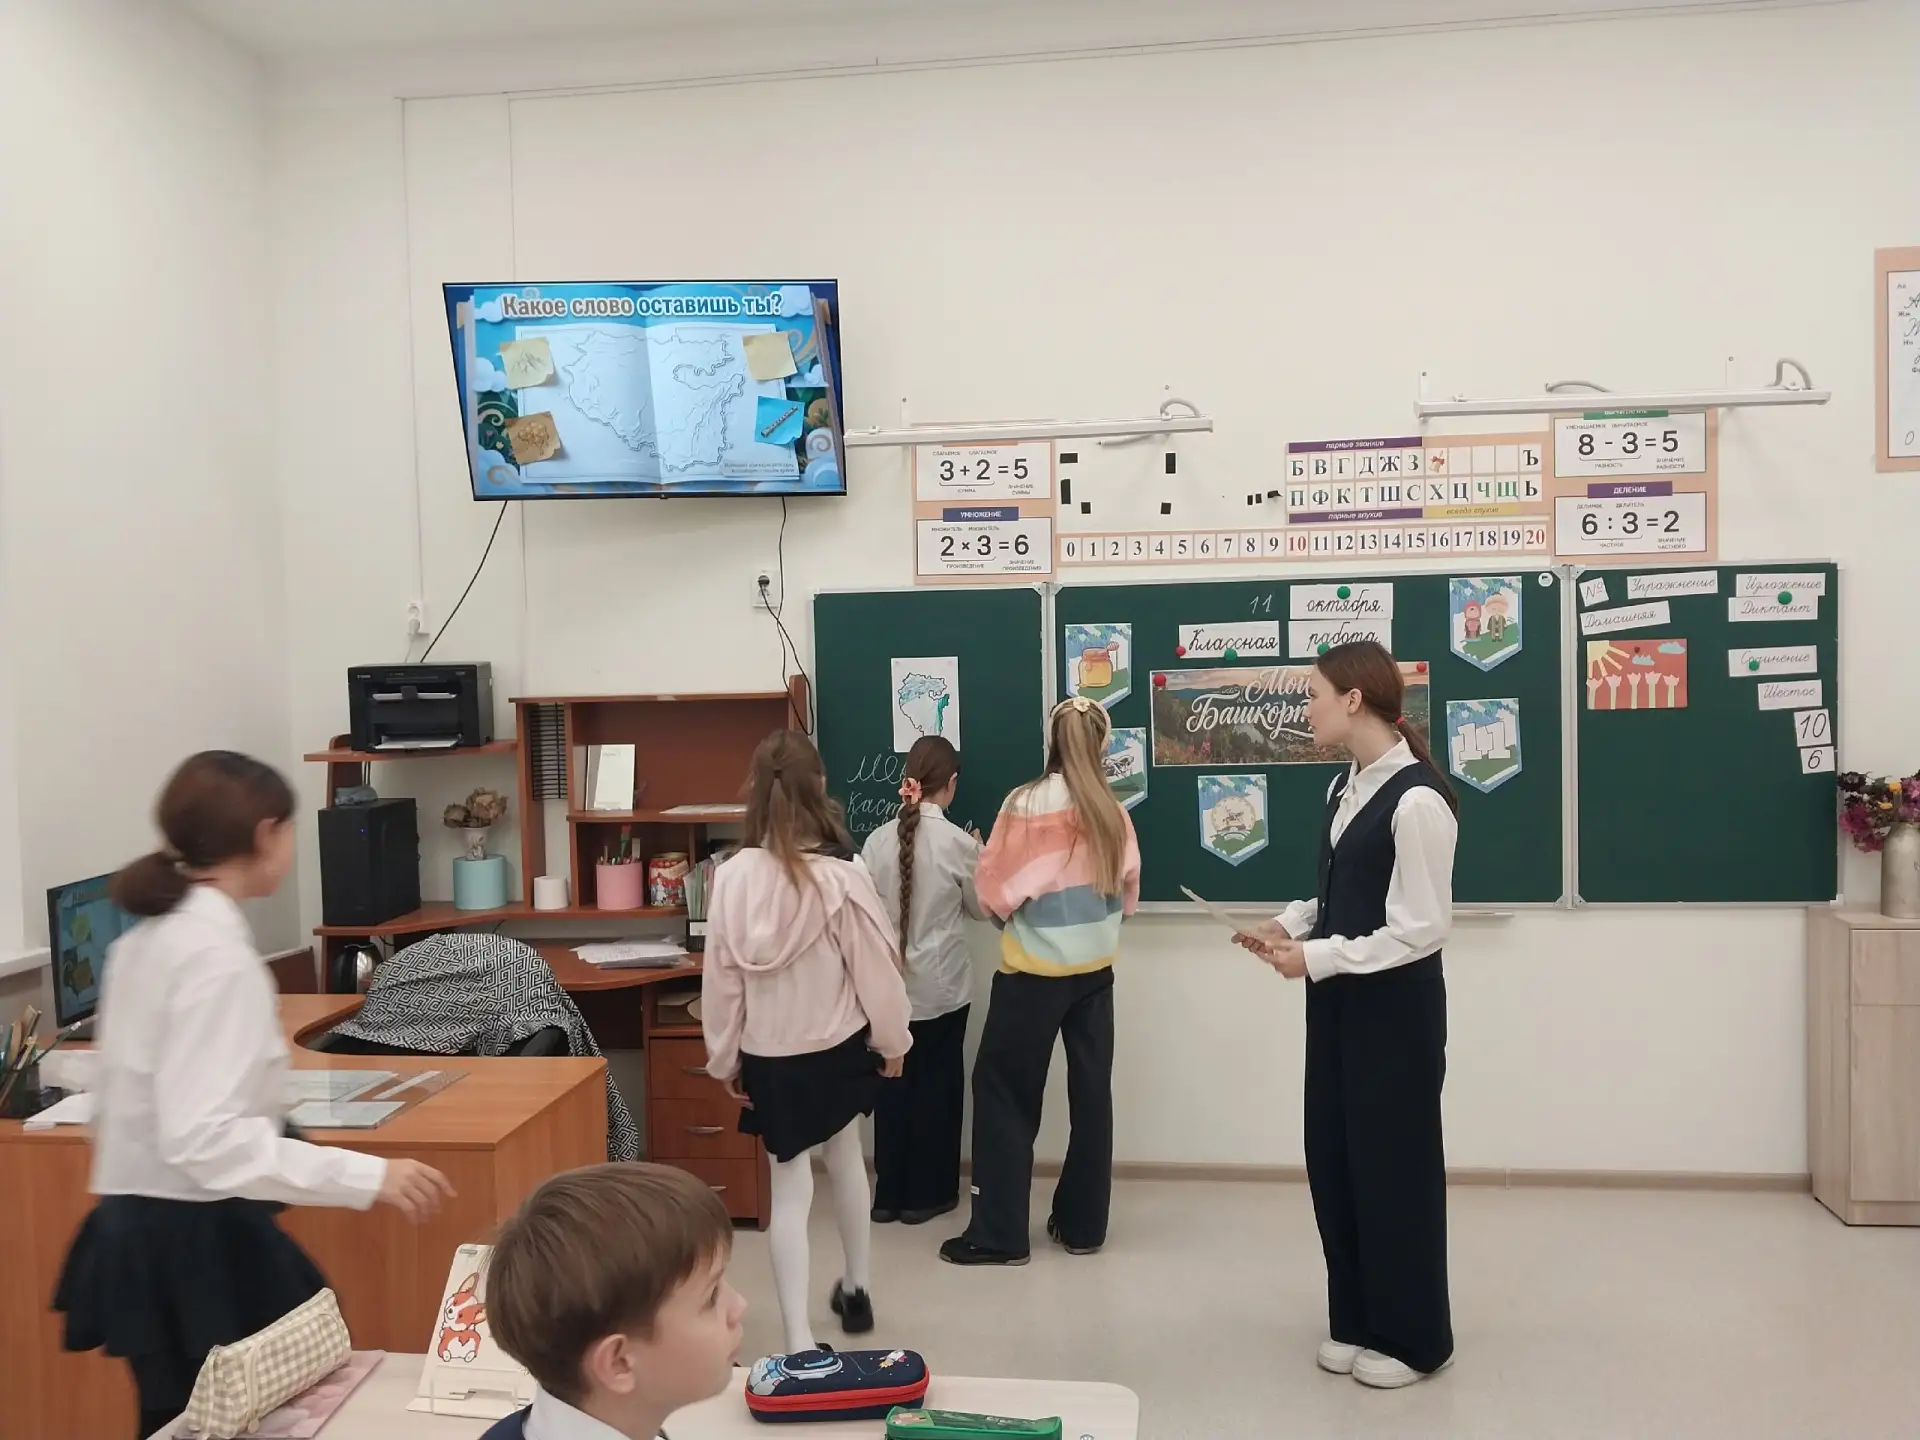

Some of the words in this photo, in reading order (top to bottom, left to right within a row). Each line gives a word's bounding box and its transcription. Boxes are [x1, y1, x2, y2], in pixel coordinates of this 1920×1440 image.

[502, 295, 567, 317] Какое
[571, 297, 633, 316] слово
[637, 297, 740, 315] оставишь
[743, 293, 783, 315] ты?
[1578, 433, 1595, 456] 8
[1621, 431, 1639, 454] 3
[1662, 430, 1679, 453] 5
[939, 459, 955, 482] 3
[976, 458, 991, 481] 2
[1013, 458, 1029, 480] 5
[1290, 460, 1304, 476] Б
[1314, 458, 1328, 475] В
[1338, 457, 1351, 474] Г
[1359, 456, 1375, 477] Д
[1379, 455, 1400, 472] Ж
[1407, 454, 1419, 471] З
[1522, 449, 1539, 466] Ъ
[1290, 490, 1304, 506] П
[1312, 489, 1329, 506] Ф
[1336, 487, 1351, 504] К
[1360, 486, 1374, 503] Т
[1380, 485, 1401, 502] Ш
[1406, 484, 1421, 501] С
[1429, 483, 1444, 500] Х
[1453, 482, 1469, 502] Ц
[1477, 481, 1491, 498] Ч
[1497, 480, 1519, 499] Щ
[1524, 480, 1538, 497] Ь
[1613, 486, 1647, 495] ДЕЛЕНИЕ
[960, 510, 1002, 519] УМНОЖЕНИЕ
[1581, 513, 1598, 536] 6
[1622, 511, 1639, 534] 3
[1663, 510, 1680, 533] 2
[940, 535, 955, 557] 2
[976, 534, 992, 556] 3
[1014, 534, 1030, 556] 6
[1066, 541, 1076, 557] 0
[1089, 541, 1097, 557] 1
[1110, 541, 1120, 556] 2
[1133, 540, 1143, 555] 3
[1154, 540, 1164, 555] 4
[1177, 539, 1187, 555] 5
[1200, 538, 1210, 554] 6
[1223, 538, 1233, 553] 7
[1246, 537, 1256, 553] 8
[1269, 536, 1279, 551] 9
[1288, 536, 1307, 551] 10
[1313, 535, 1328, 551] 11
[1336, 535, 1354, 550] 12
[1359, 534, 1378, 549] 13
[1383, 533, 1402, 549] 14
[1407, 532, 1426, 548] 15
[1430, 532, 1449, 547] 16
[1454, 531, 1473, 547] 17
[1478, 530, 1497, 546] 18
[1502, 529, 1521, 545] 19
[1525, 528, 1545, 545] 20
[1630, 577, 1716, 597] Упражнение
[1745, 575, 1822, 595] Изложение
[1249, 594, 1273, 615] 11
[1306, 588, 1384, 620] октября.
[1740, 600, 1812, 615] Диктант
[1583, 612, 1657, 629] Домашняя
[1188, 628, 1279, 651] Классная
[1245, 667, 1311, 703] Мой
[1763, 684, 1817, 699] Шестое
[1186, 692, 1313, 740] Башкорт
[1800, 712, 1827, 739] 10
[1807, 749, 1823, 770] 6
